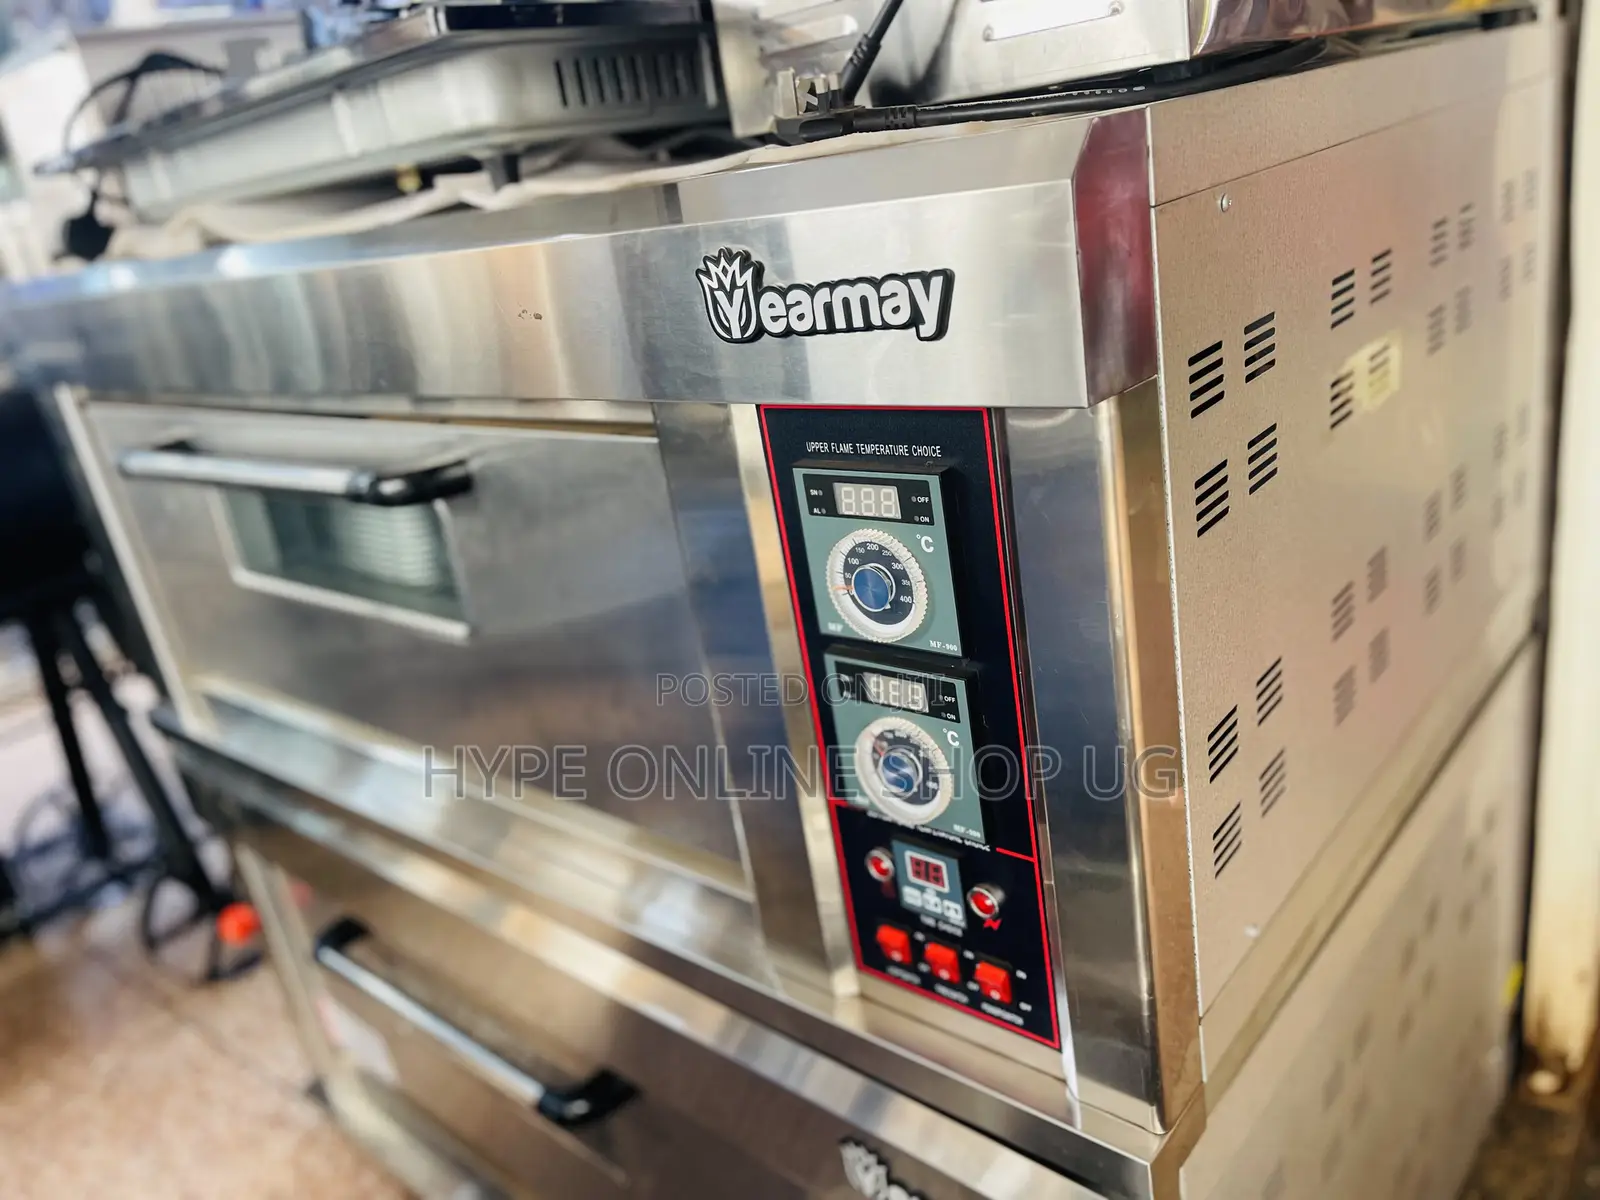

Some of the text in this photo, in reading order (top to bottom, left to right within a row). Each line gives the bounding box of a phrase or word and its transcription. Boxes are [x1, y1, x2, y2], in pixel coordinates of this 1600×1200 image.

[697, 248, 954, 343] Yearmay
[806, 441, 942, 458] UPPER FLAME TEMPERATURE CHOICE
[919, 515, 930, 523] ON
[855, 546, 865, 554] 150
[866, 542, 879, 551] 200
[881, 548, 892, 557] 250
[847, 557, 860, 566] 100
[891, 562, 904, 571] 300
[899, 595, 912, 603] 400
[929, 640, 958, 652] MF-900
[943, 695, 956, 703] OFF
